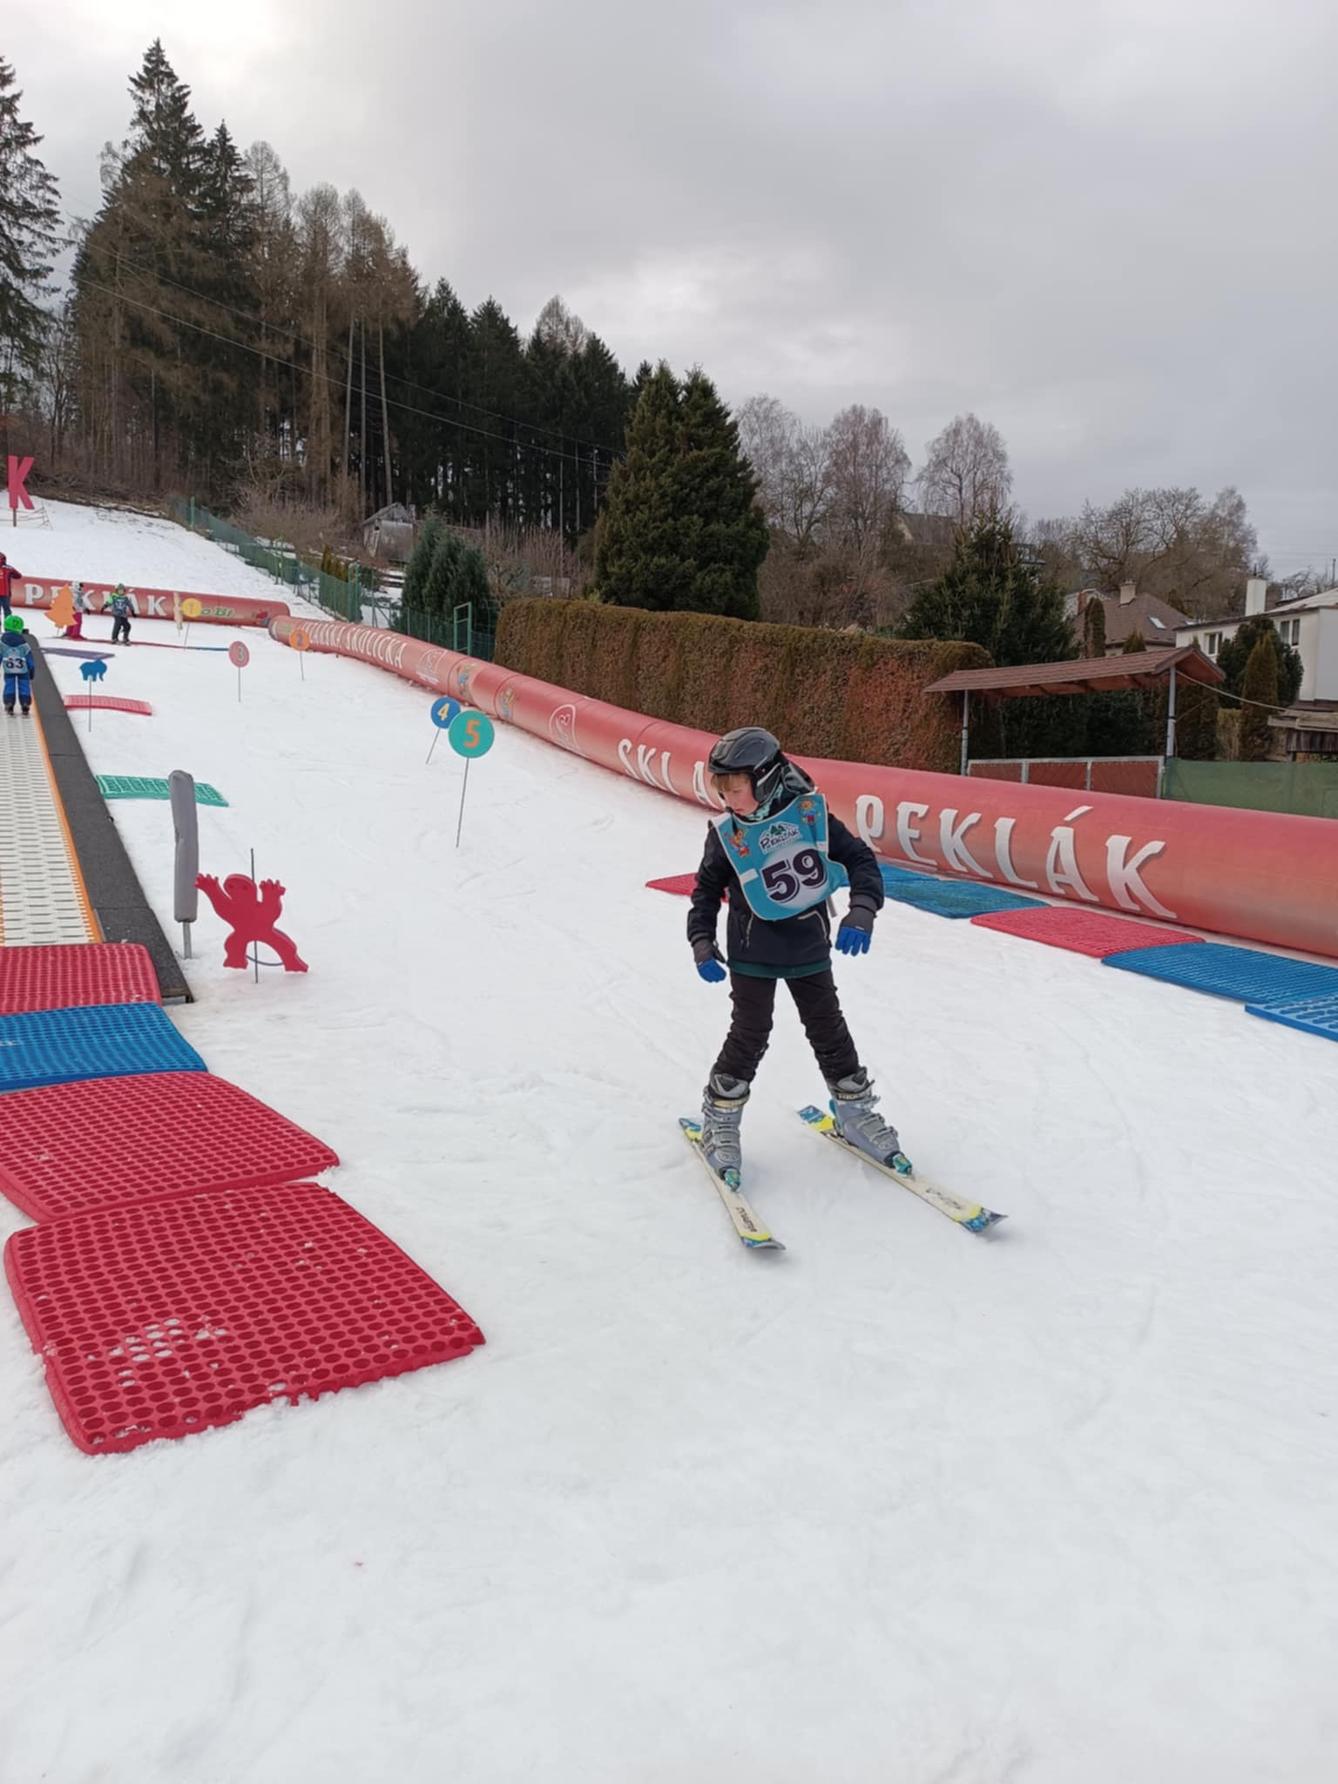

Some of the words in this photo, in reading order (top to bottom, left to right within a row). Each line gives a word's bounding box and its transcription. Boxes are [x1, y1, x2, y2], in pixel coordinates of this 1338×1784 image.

[8, 455, 35, 510] K
[237, 645, 245, 662] 3
[437, 702, 451, 721] 4
[464, 719, 481, 749] 5
[618, 738, 680, 796] SKI
[855, 794, 1177, 918] PEKLÁK
[761, 848, 829, 903] 59
